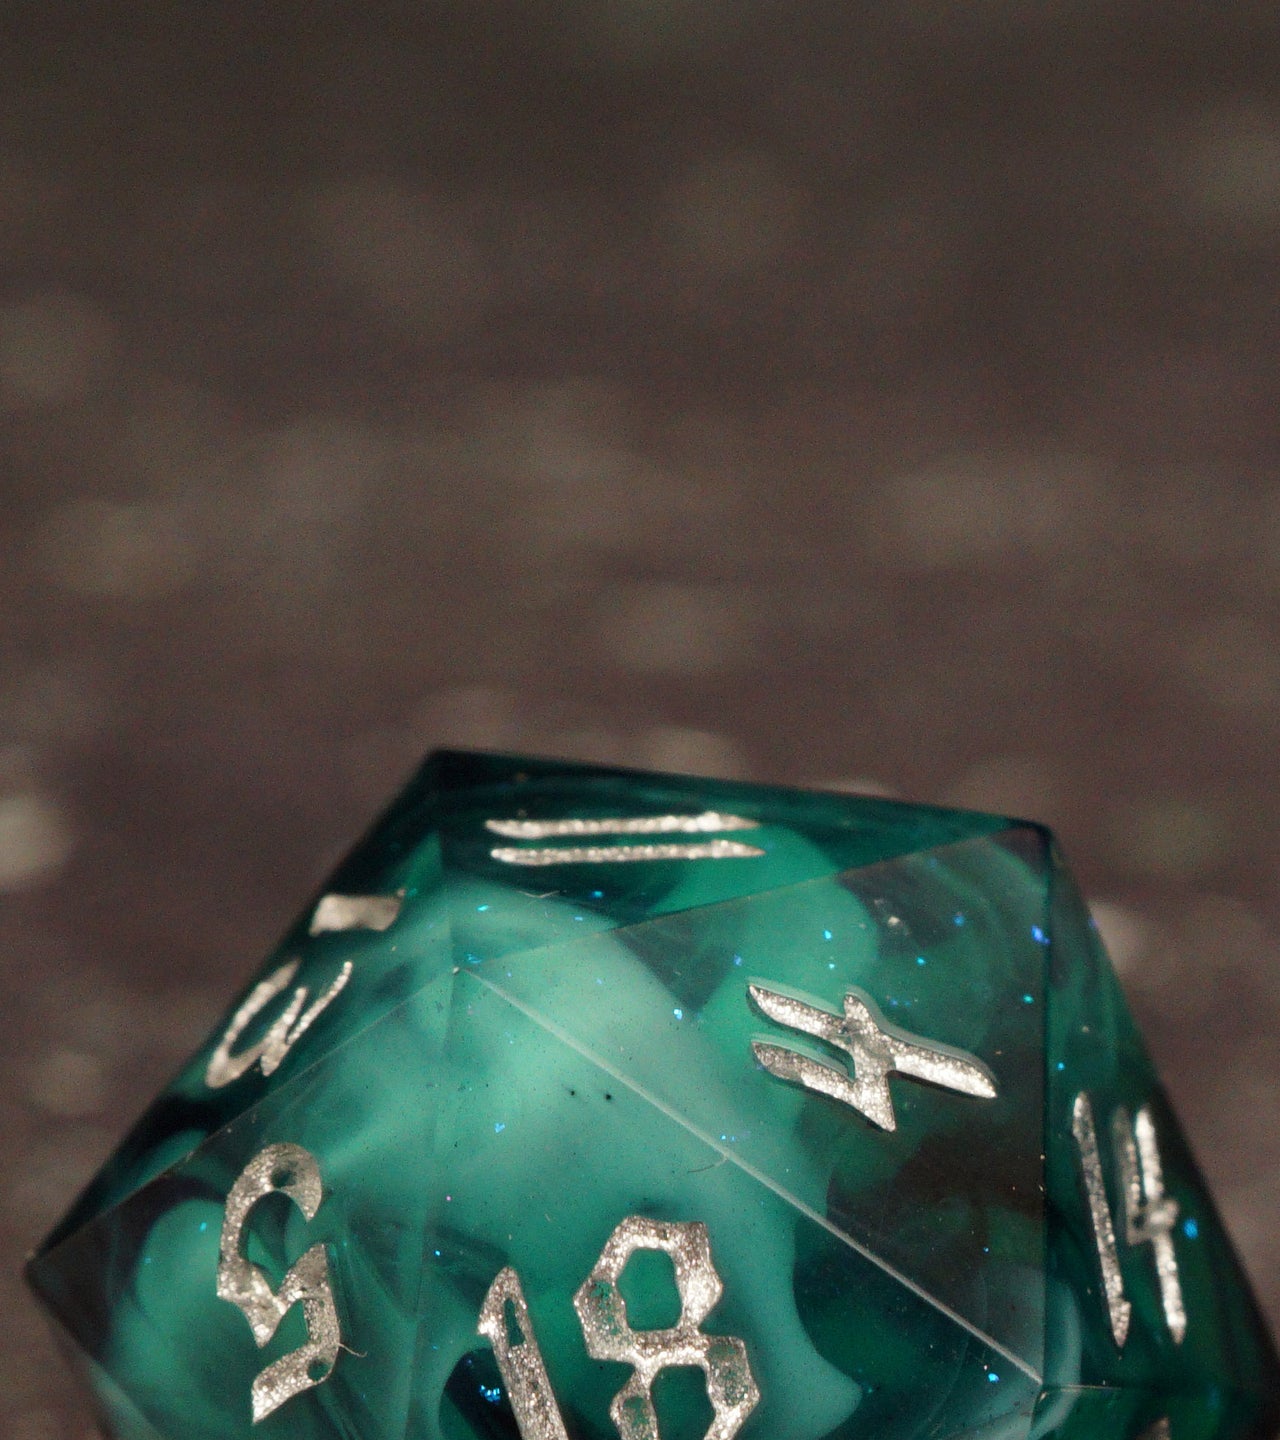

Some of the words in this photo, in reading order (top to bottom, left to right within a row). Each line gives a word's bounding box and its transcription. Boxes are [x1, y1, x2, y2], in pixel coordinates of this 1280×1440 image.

[744, 975, 998, 1134] 4
[215, 1141, 336, 1426] 5
[1073, 1091, 1187, 1348] 14
